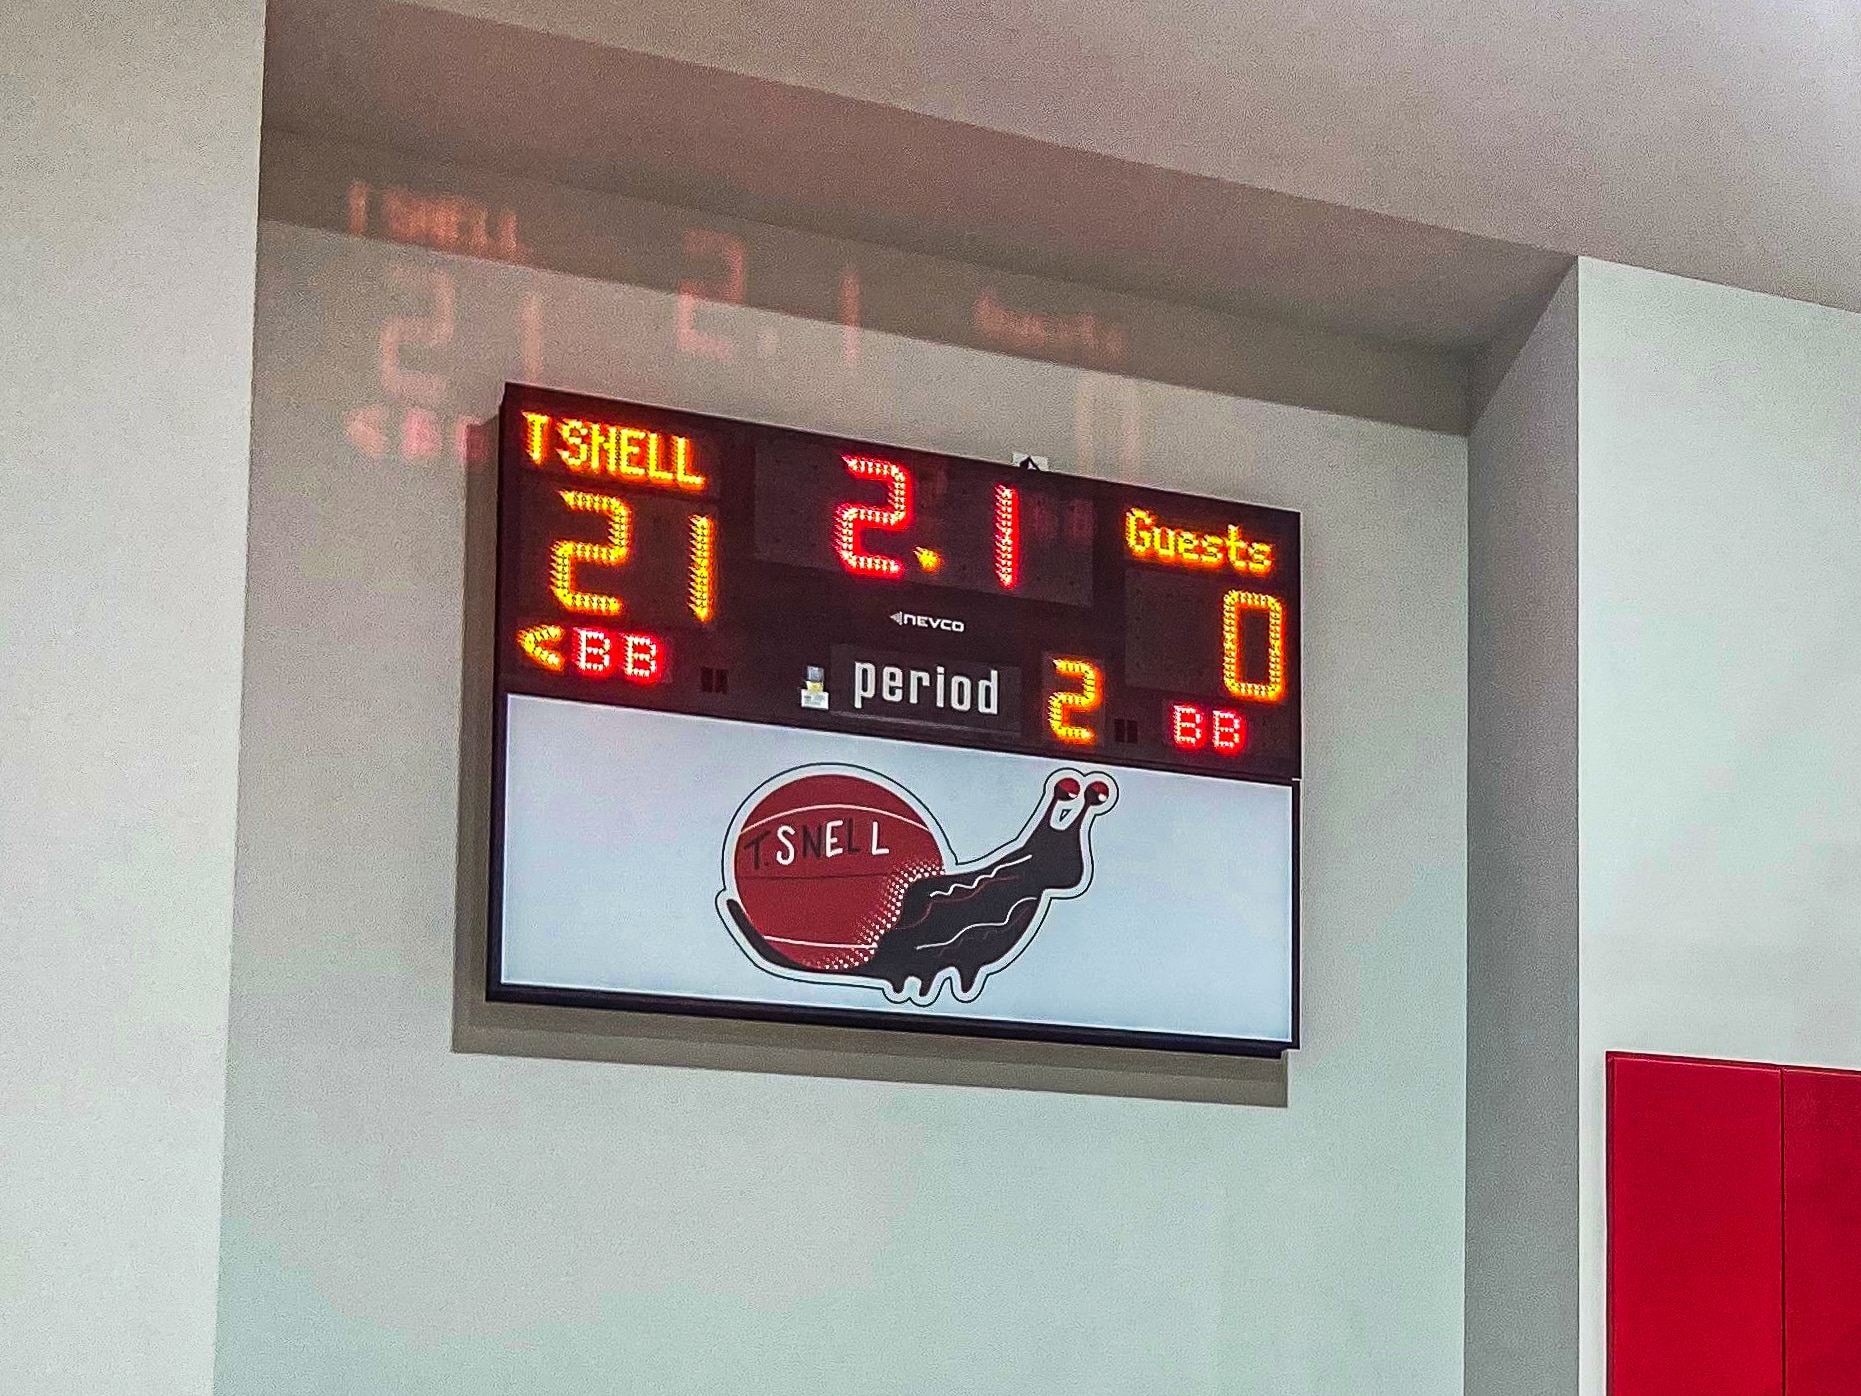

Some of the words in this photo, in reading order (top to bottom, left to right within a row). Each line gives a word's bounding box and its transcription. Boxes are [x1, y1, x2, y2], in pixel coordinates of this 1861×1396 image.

[549, 489, 715, 623] 21
[1124, 506, 1275, 576] Guests
[854, 660, 999, 716] period
[1221, 588, 1286, 701] 0
[1047, 657, 1104, 745] 2
